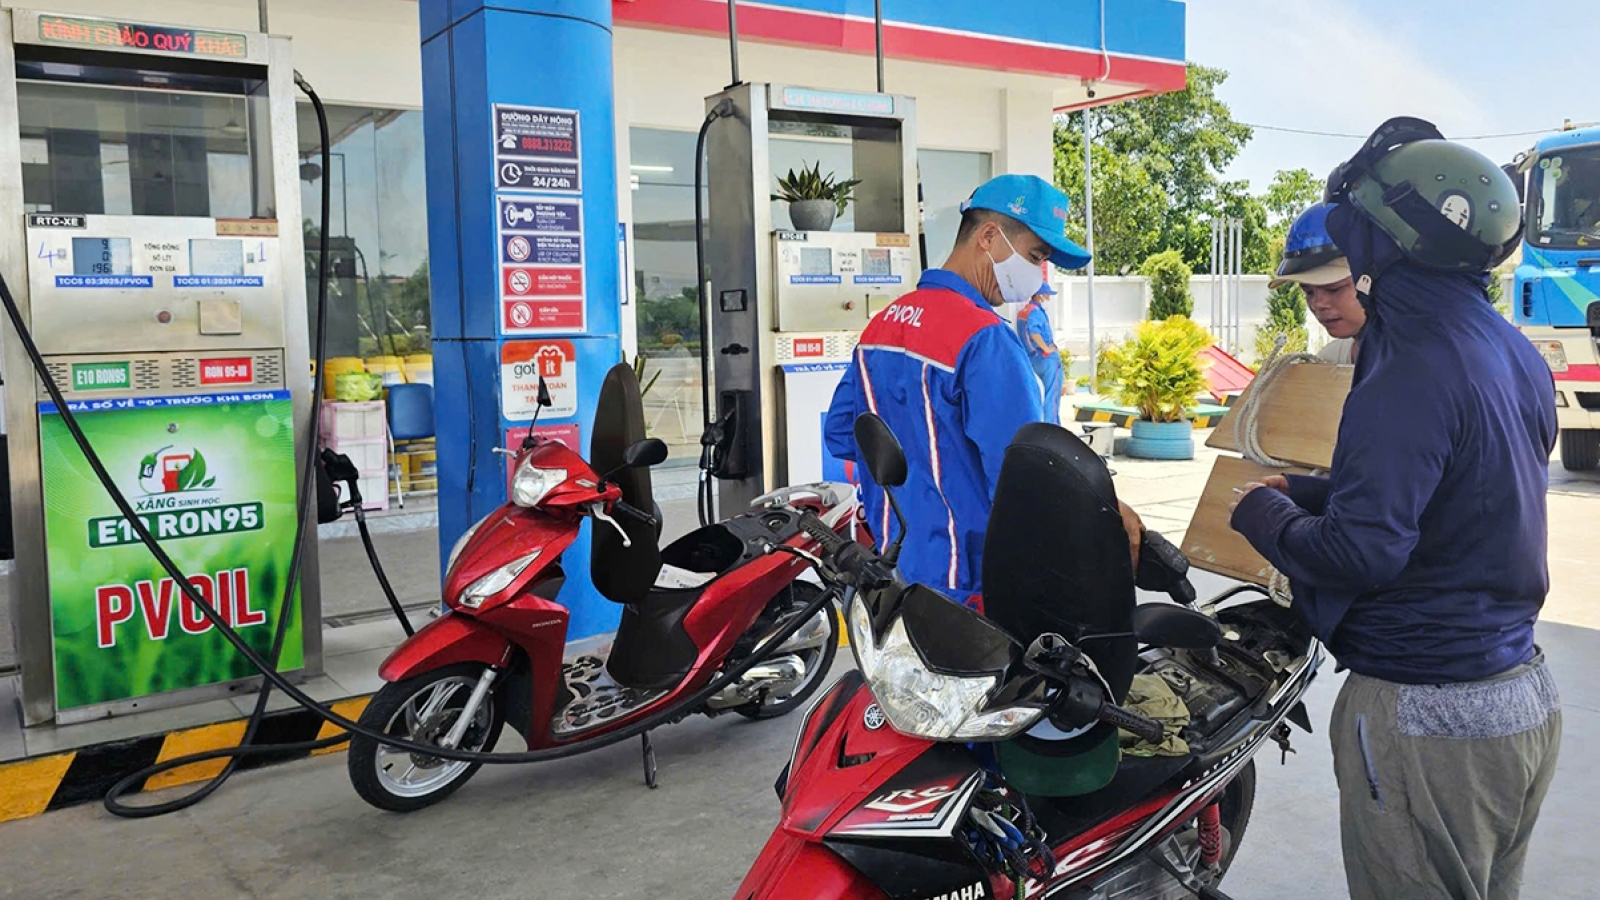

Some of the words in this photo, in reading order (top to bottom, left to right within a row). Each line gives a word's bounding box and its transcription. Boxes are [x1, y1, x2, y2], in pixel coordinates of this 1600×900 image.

[94, 24, 149, 47] CHÀO
[152, 32, 193, 52] QUÝ
[532, 175, 571, 188] 24/24h
[36, 217, 79, 227] RTC-XE
[883, 304, 925, 328] PVOIL
[76, 370, 94, 385] E10
[96, 368, 126, 384] RON95
[204, 366, 223, 378] RON
[514, 361, 536, 379] got
[545, 360, 556, 375] it
[512, 384, 540, 392] THAN
[92, 399, 113, 409] SỐ
[117, 398, 135, 408] VỀ
[165, 396, 213, 405] TRƯỚC
[135, 496, 176, 511] XĂNG
[177, 499, 199, 508] SINH
[157, 505, 258, 538] RON95
[95, 567, 266, 648] PVOIL
